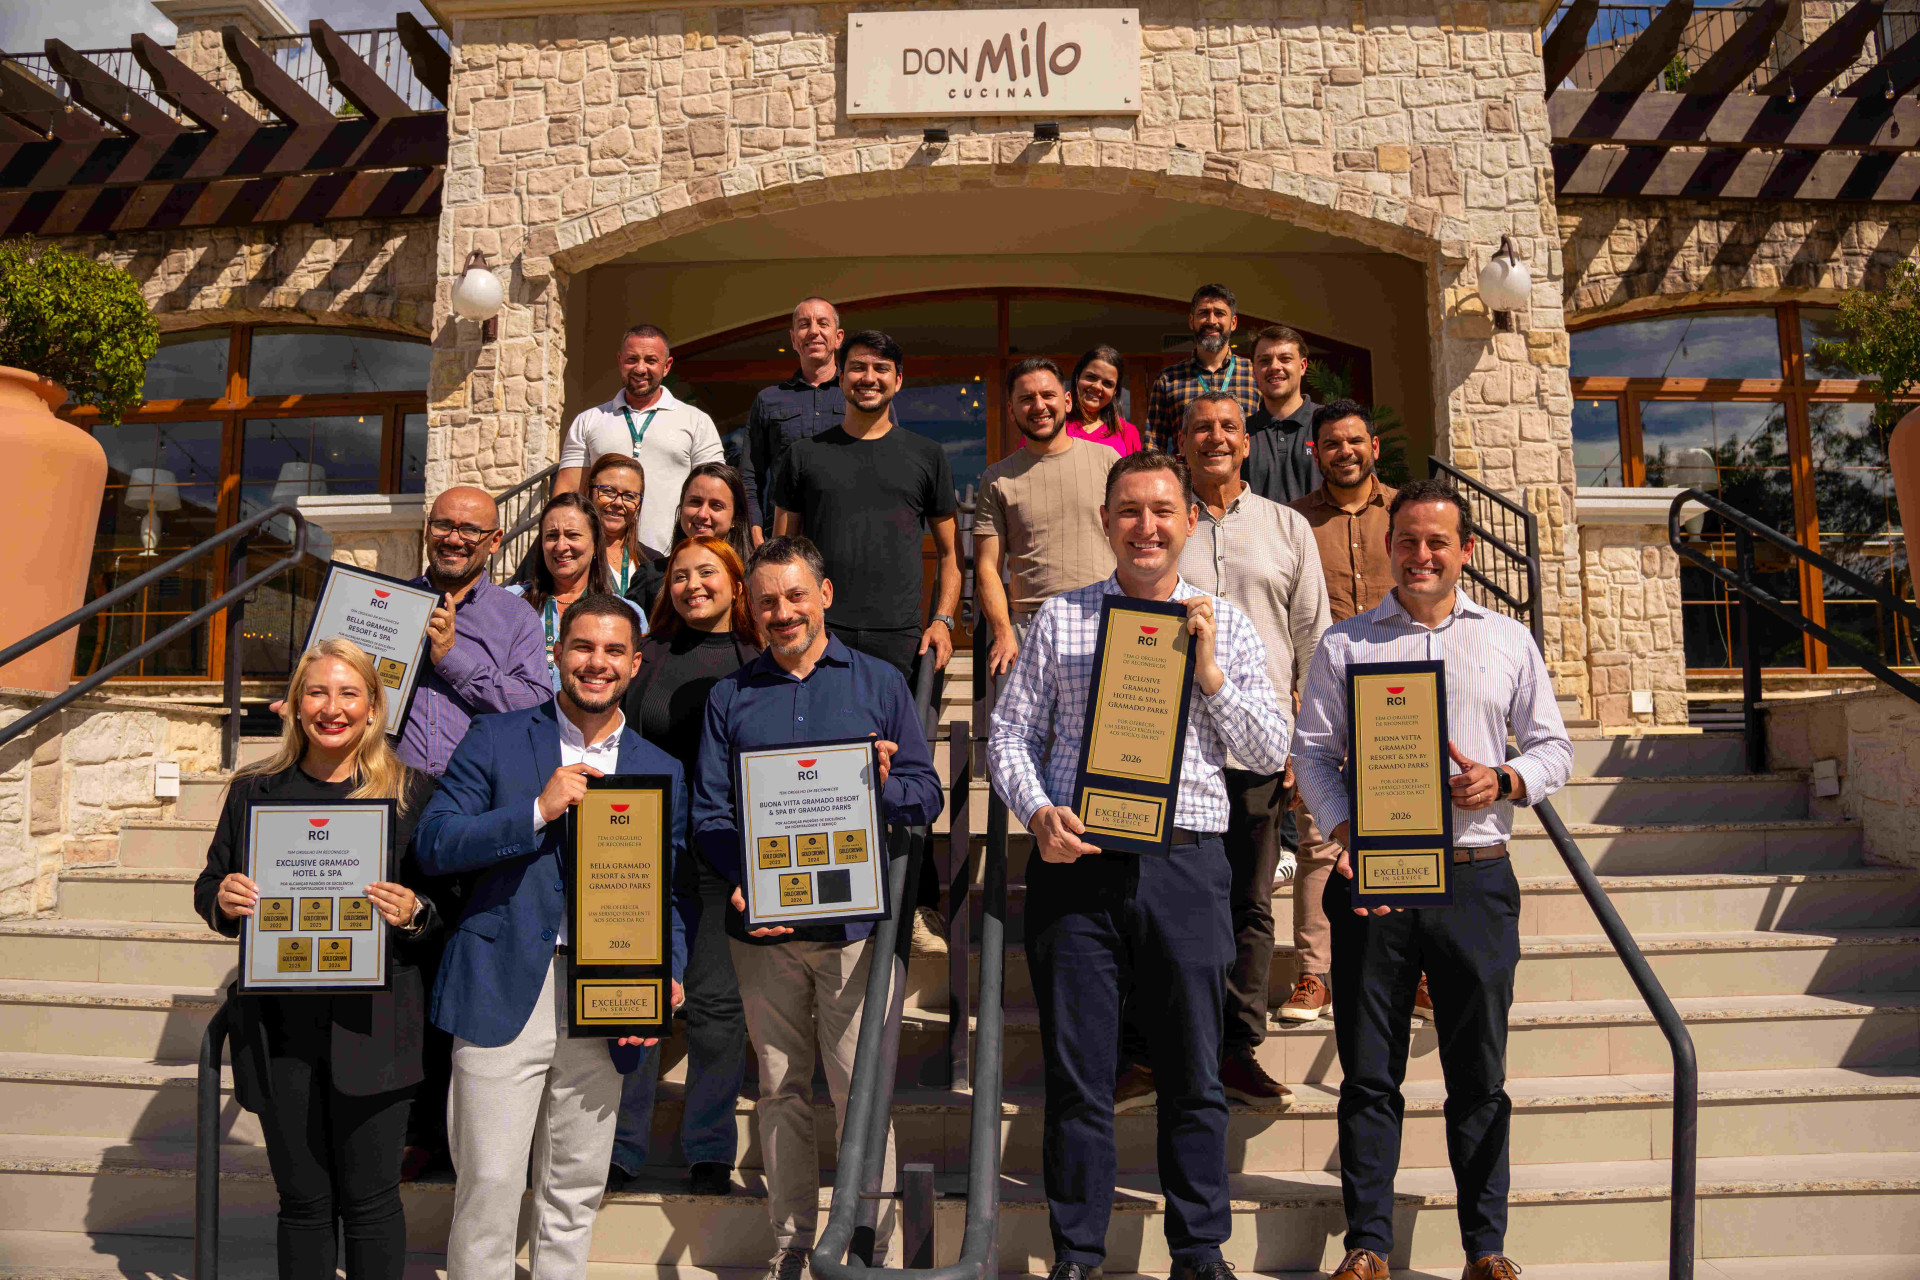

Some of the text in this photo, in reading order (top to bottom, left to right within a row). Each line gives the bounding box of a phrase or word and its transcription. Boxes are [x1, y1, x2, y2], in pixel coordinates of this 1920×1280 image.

[903, 22, 1082, 97] DON Milo
[948, 88, 1032, 98] CUCINA
[370, 598, 388, 610] RCI
[347, 615, 365, 625] BELLA
[366, 621, 398, 635] GRAMADO
[348, 624, 372, 636] RESORT
[379, 634, 391, 642] SPA
[1138, 636, 1157, 646] RCI
[1124, 674, 1161, 684] EXCLUSIVE
[1122, 684, 1160, 694] GRAMADO
[1113, 692, 1136, 701] HOTEL
[1387, 697, 1406, 706] RCI
[1108, 702, 1168, 715] GRAMADO PARKS
[1120, 754, 1142, 763] 2026
[797, 770, 818, 780] RCI
[802, 796, 834, 805] GRAMADO
[836, 795, 860, 803] RESORT
[798, 806, 831, 814] GRAMADO
[1095, 808, 1150, 822] EXCELLENCE
[610, 815, 630, 824] RCI
[1390, 812, 1411, 820] 2026
[1112, 818, 1141, 826] SERVICE
[308, 830, 329, 840] RCI
[276, 858, 360, 867] EXCLUSIVE GRAMADO
[1374, 867, 1430, 877] EXCELLENCE
[609, 940, 630, 948] 2026
[592, 999, 648, 1008] EXCELLENCE
